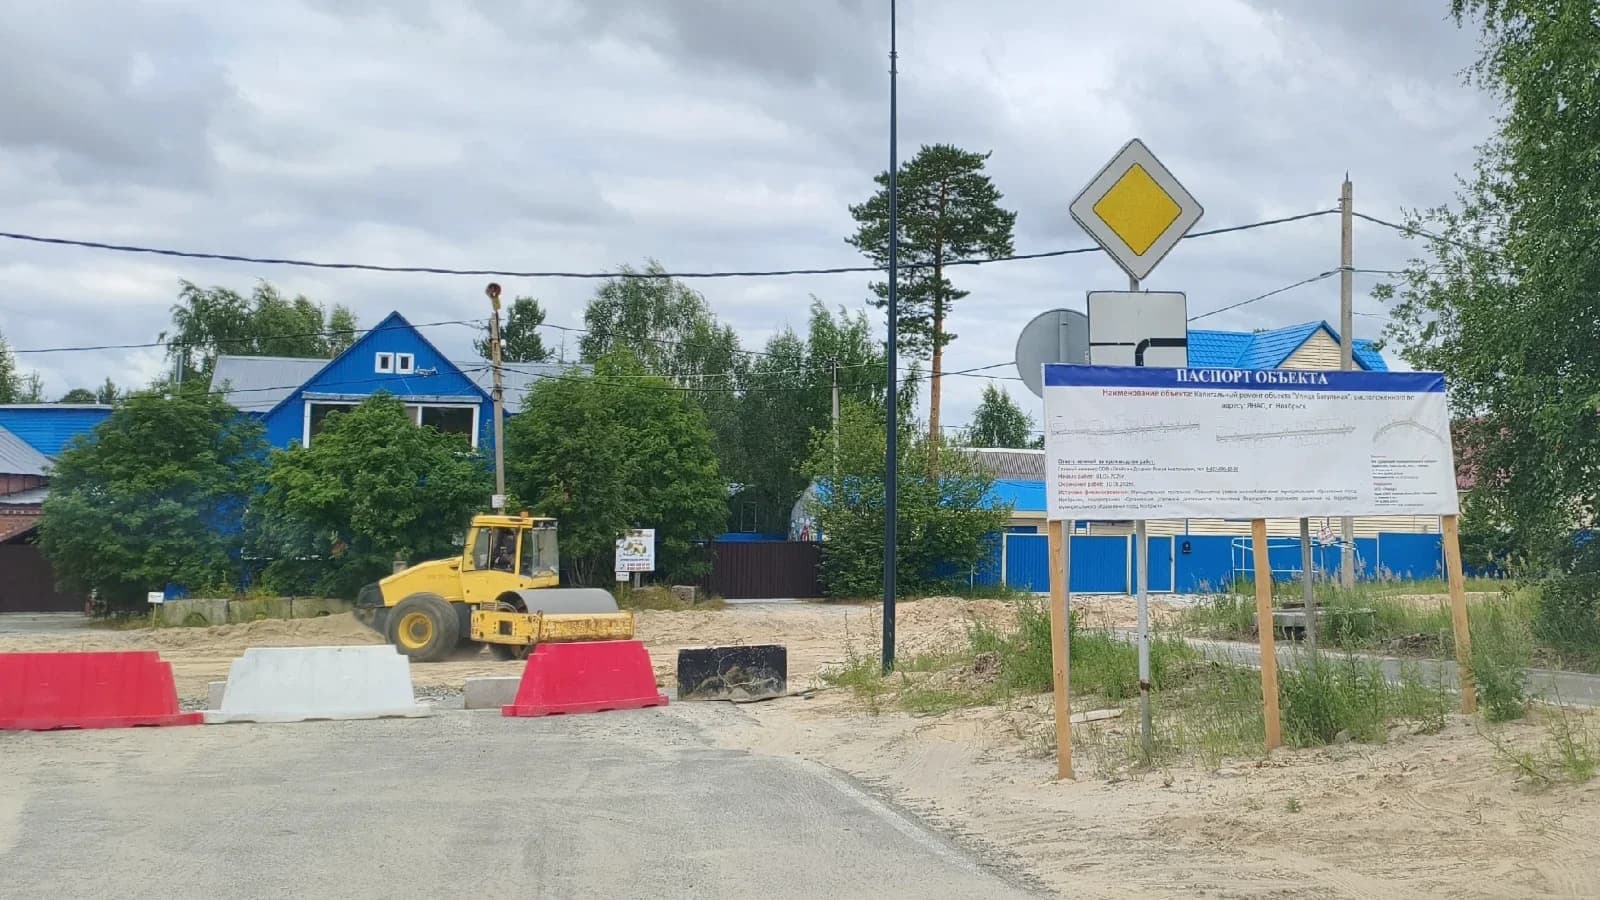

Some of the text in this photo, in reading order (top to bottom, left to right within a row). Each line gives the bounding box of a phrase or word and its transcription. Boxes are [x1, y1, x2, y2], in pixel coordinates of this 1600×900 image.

[1176, 369, 1329, 385] ПАСПОРТ ОБЪЕКТА
[1102, 388, 1160, 398] Наименование
